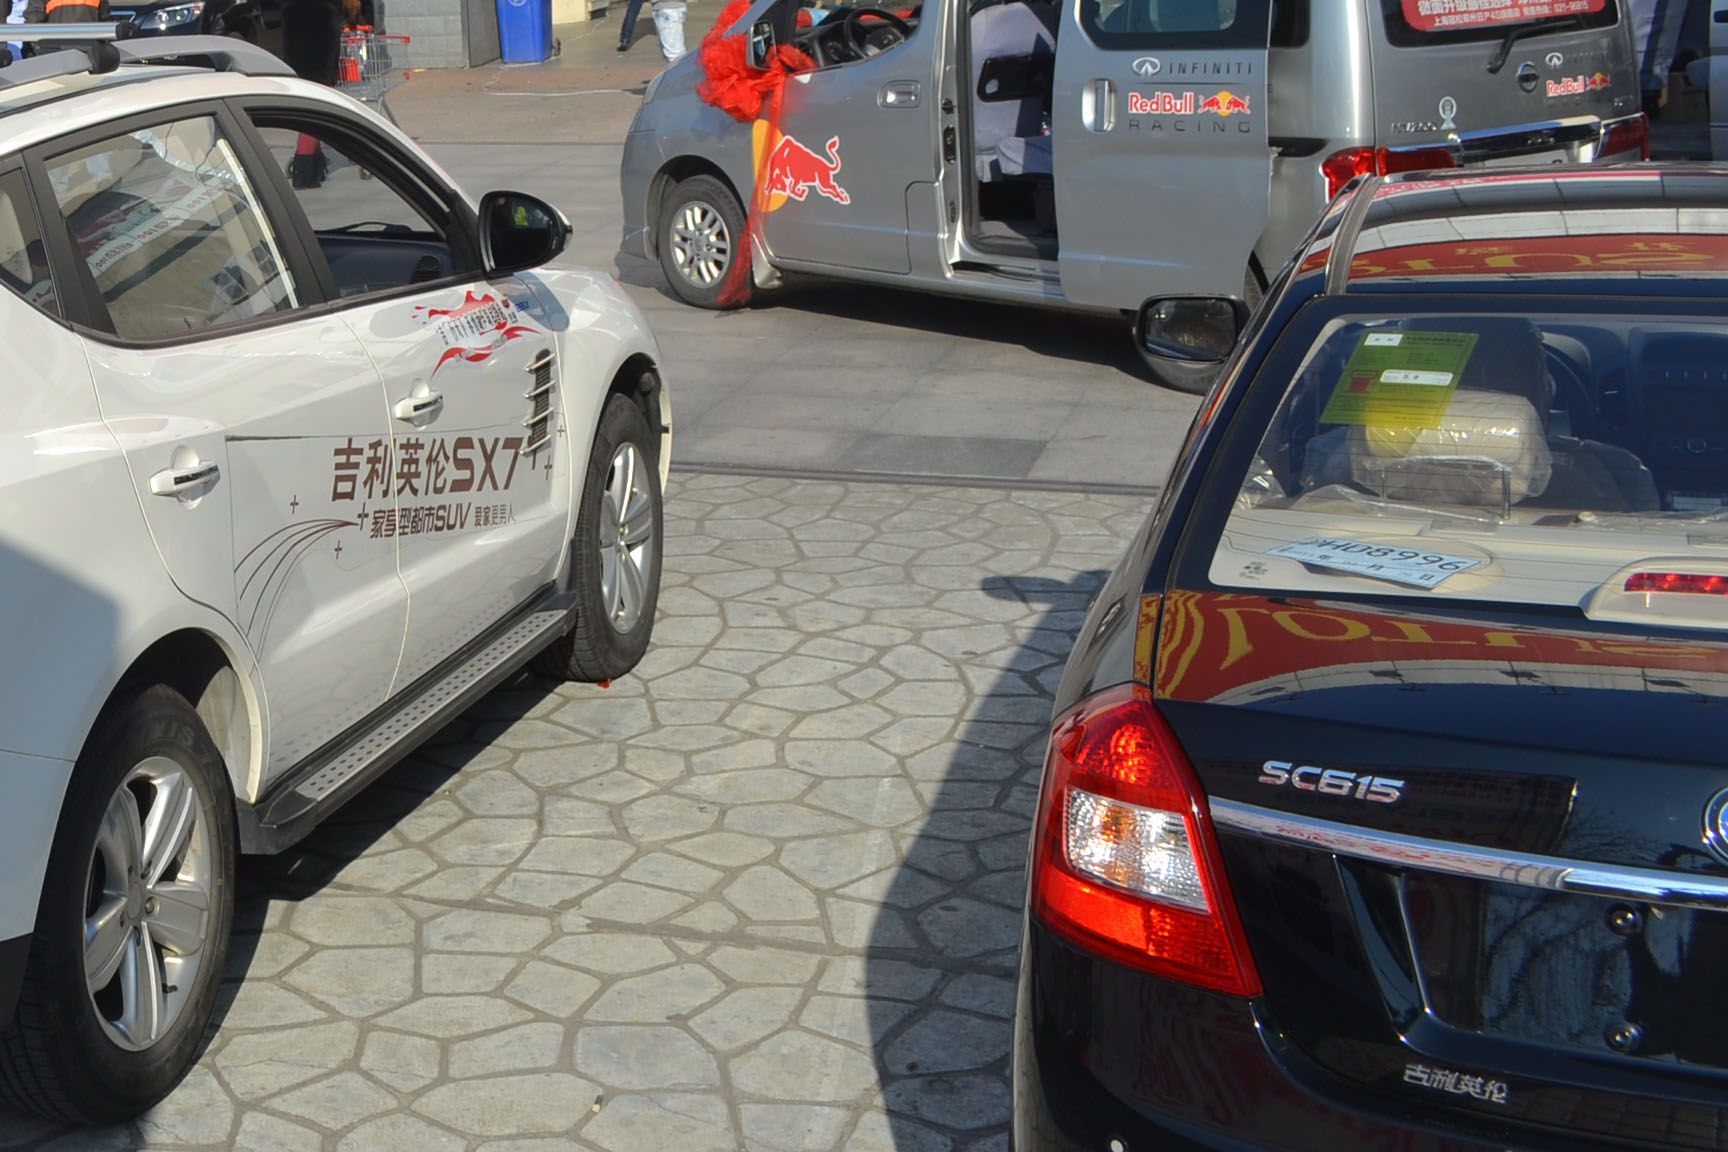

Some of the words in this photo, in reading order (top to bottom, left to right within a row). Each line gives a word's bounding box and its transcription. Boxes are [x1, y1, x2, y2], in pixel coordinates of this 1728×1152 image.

[1168, 61, 1253, 75] INFINITI
[1546, 77, 1567, 97] Red
[1566, 74, 1585, 94] Bull
[1128, 91, 1161, 114] Red
[1161, 91, 1195, 114] Bull
[1128, 118, 1251, 134] RACING
[331, 436, 525, 502] 吉利英伦SX7
[1257, 759, 1407, 804] SC615
[1403, 1064, 1509, 1105] 吉利英伦
